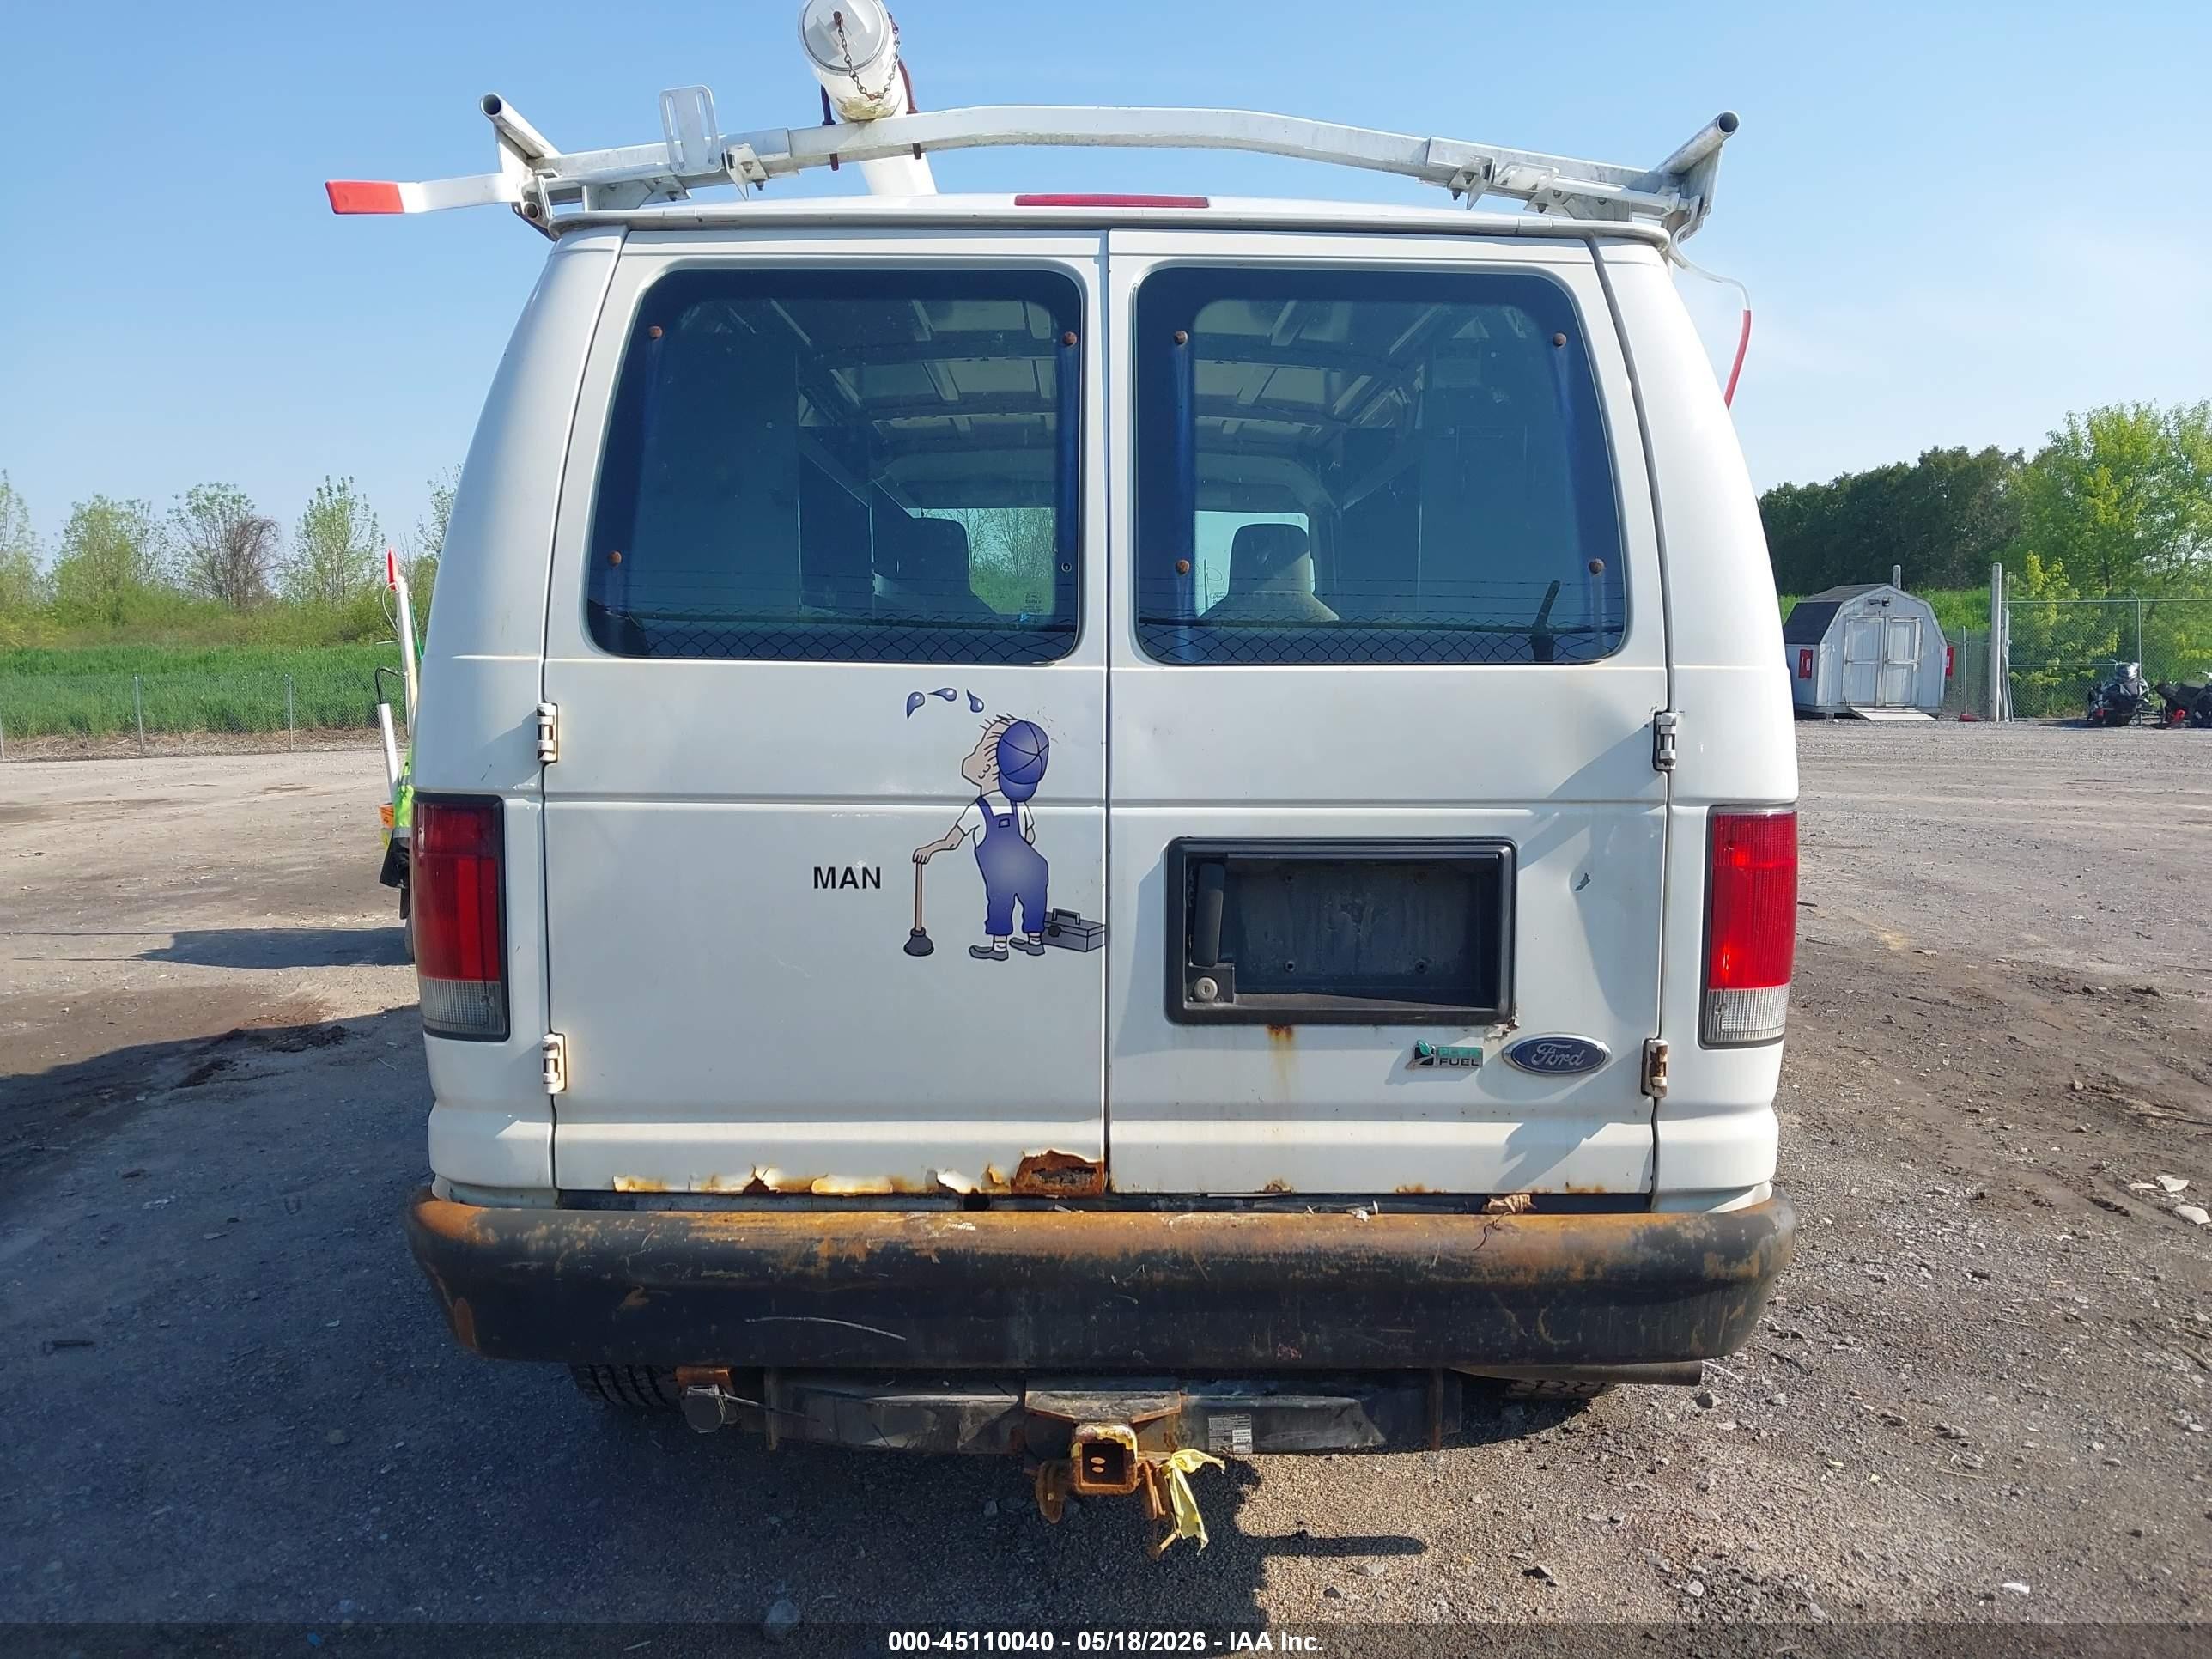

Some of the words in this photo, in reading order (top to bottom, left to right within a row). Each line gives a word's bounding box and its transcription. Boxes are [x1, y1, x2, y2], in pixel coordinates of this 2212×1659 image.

[813, 866, 881, 890] MAN
[1439, 1058, 1480, 1066] FUEL
[1531, 1042, 1585, 1066] Ford
